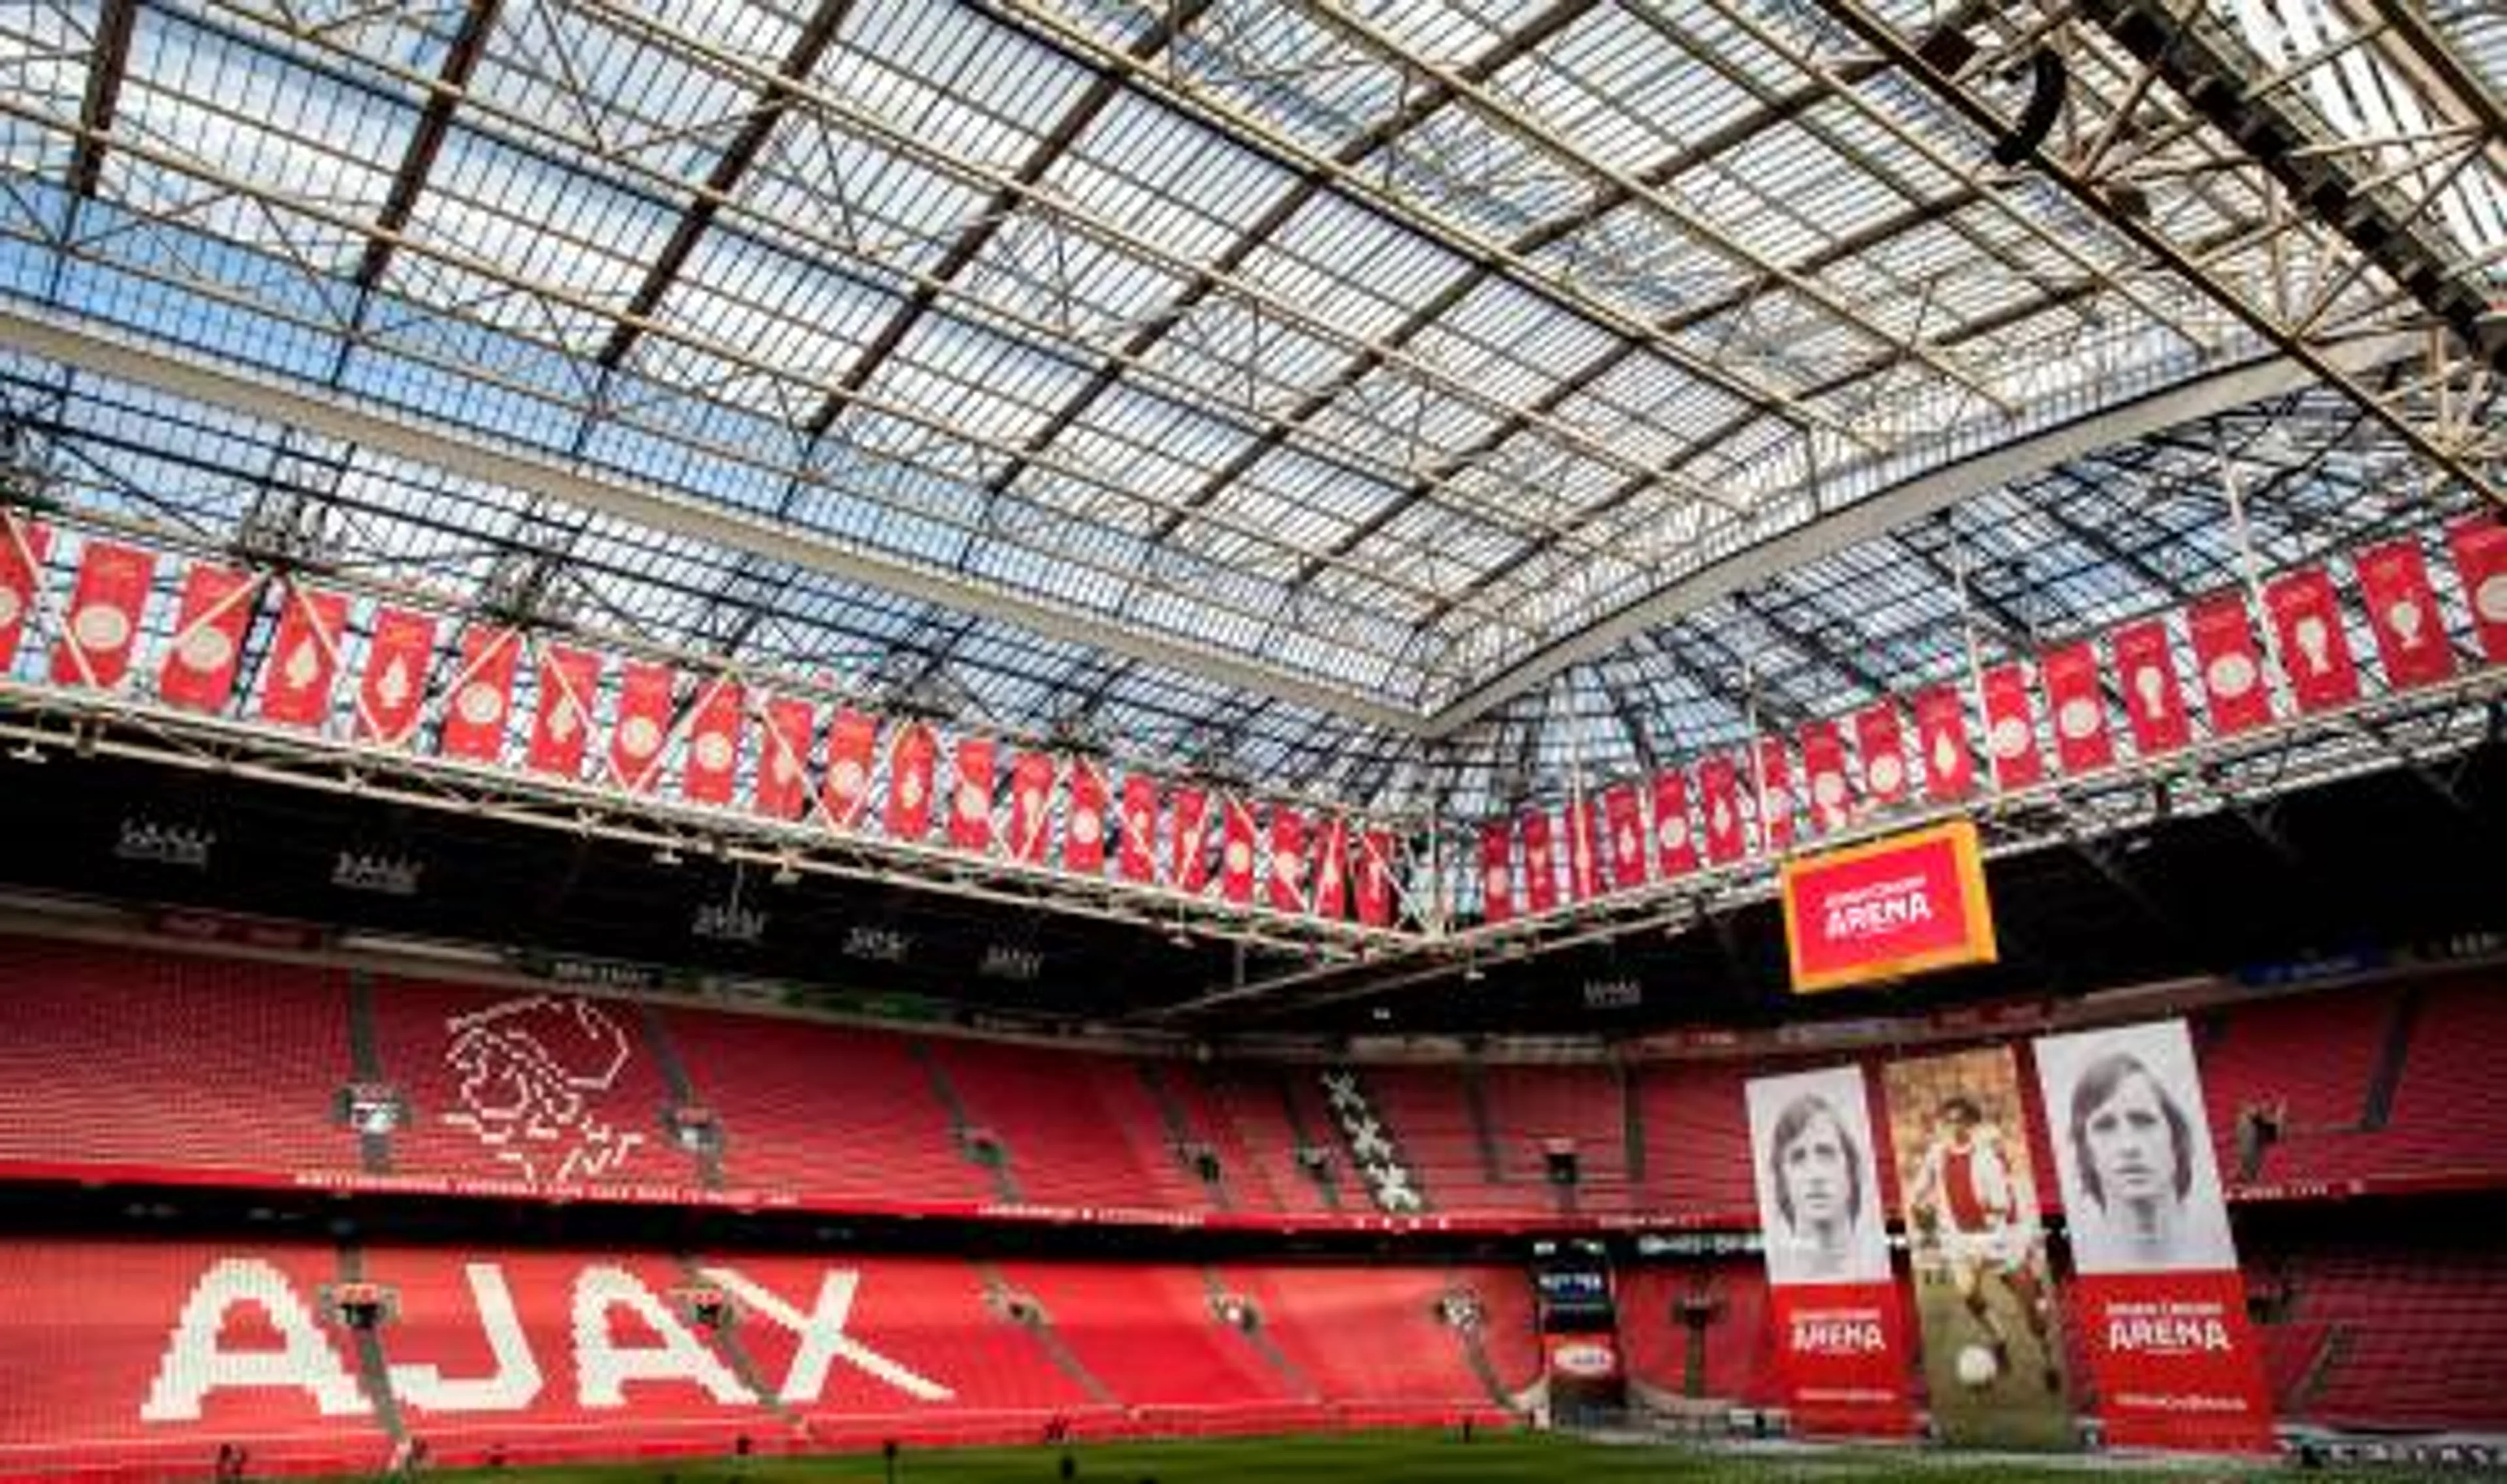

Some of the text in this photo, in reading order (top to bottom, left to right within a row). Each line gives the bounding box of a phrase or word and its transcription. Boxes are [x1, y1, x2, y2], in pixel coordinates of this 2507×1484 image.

[1824, 891, 1932, 940] ARENA
[140, 1257, 955, 1420] AJAX
[1790, 1323, 1887, 1353] ARENA
[2109, 1318, 2233, 1351] ARENA
